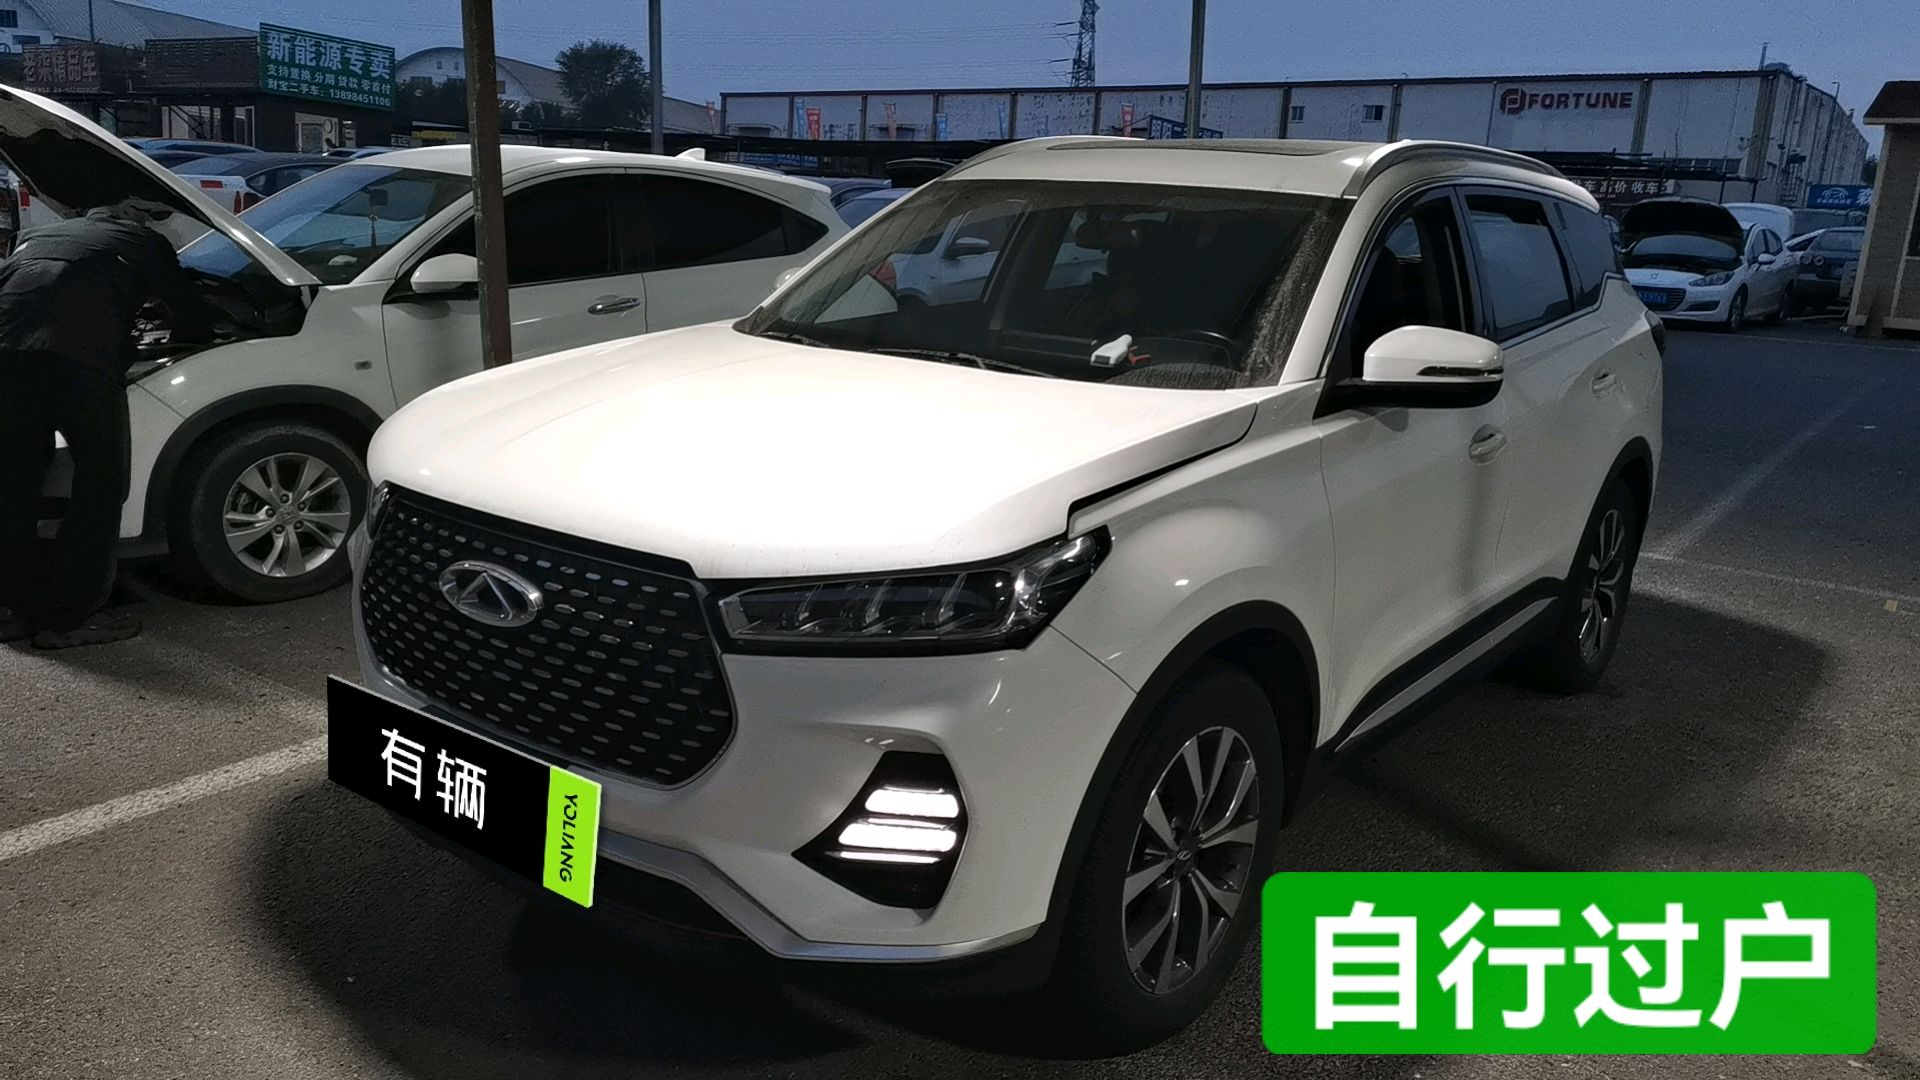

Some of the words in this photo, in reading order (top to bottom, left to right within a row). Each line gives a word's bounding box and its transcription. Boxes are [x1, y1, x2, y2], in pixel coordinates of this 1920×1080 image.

[266, 31, 391, 80] 新能源专卖
[1528, 91, 1634, 110] FORTUNE
